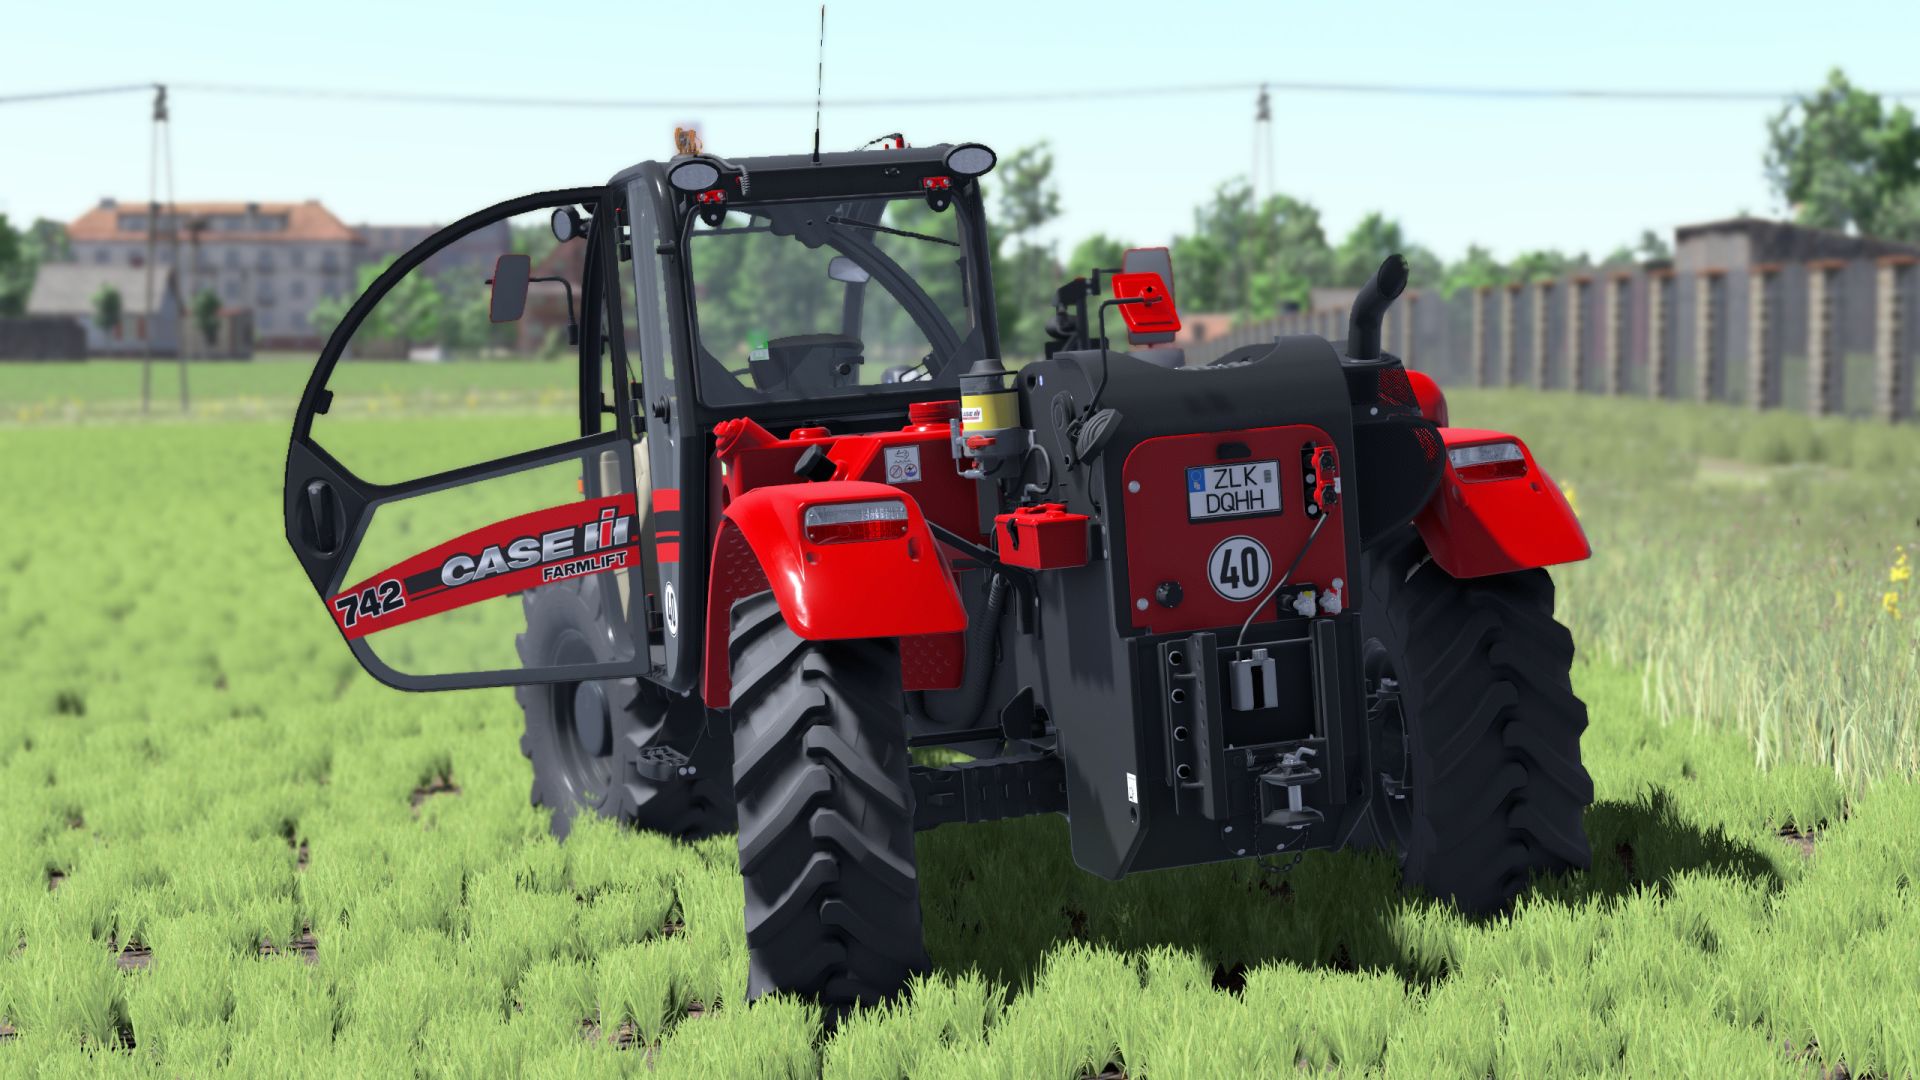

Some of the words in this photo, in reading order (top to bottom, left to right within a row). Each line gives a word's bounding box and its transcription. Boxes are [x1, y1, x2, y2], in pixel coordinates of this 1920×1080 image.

[1214, 466, 1257, 490] ZLK
[1206, 489, 1265, 514] DQHH
[441, 528, 575, 586] CASE
[543, 551, 627, 582] FARMLIFT
[1220, 546, 1259, 589] 40
[335, 578, 406, 628] 742
